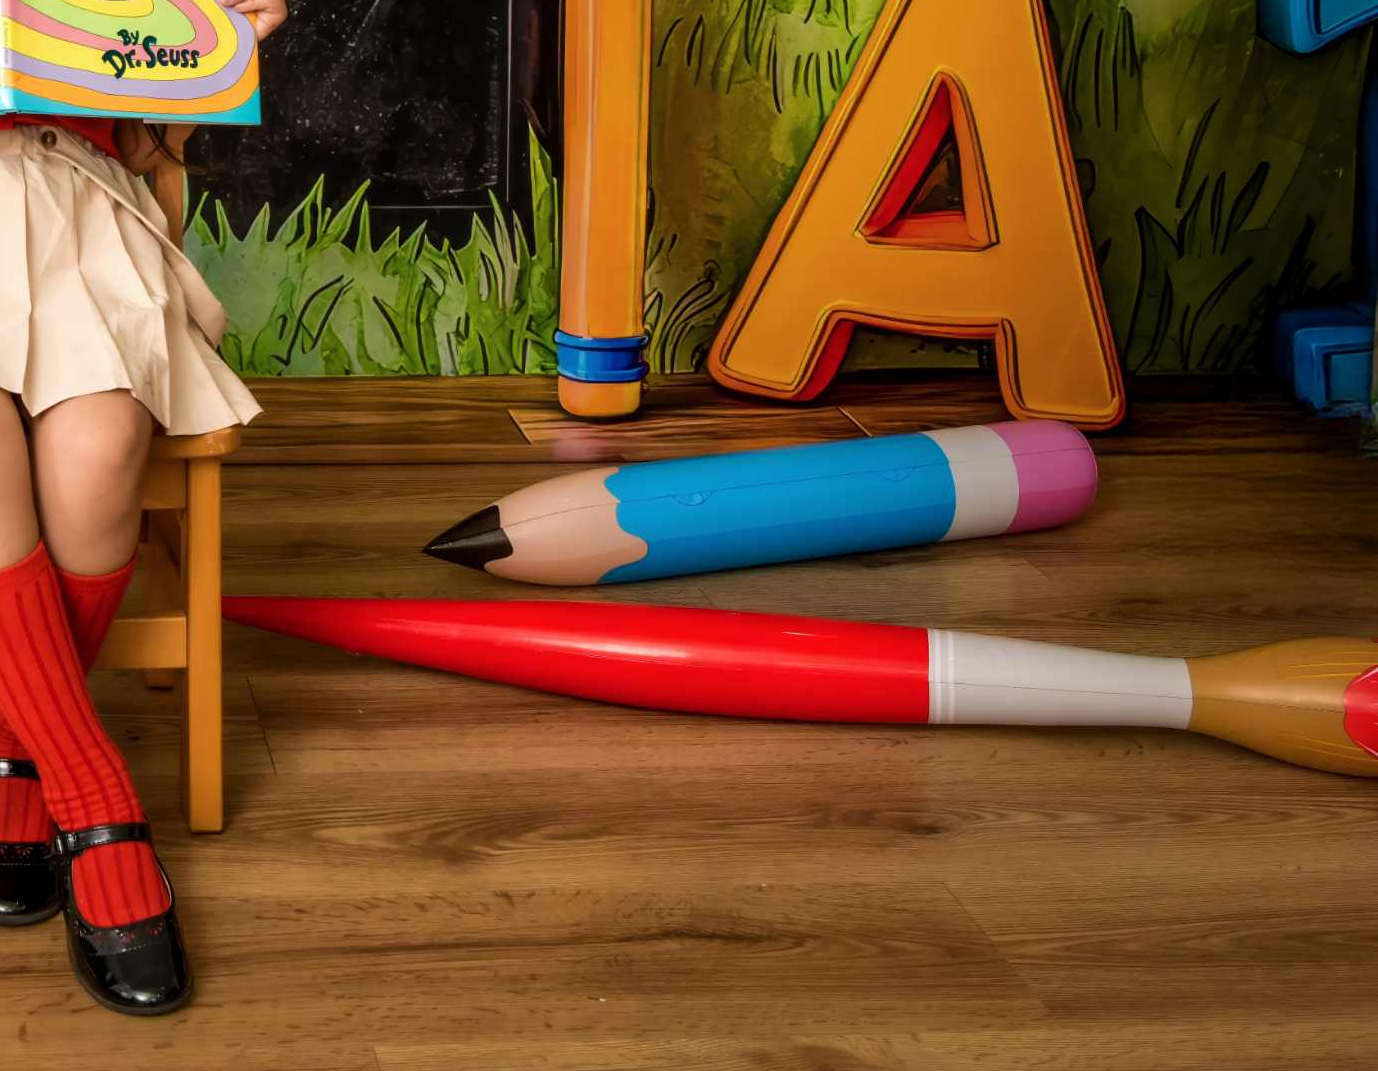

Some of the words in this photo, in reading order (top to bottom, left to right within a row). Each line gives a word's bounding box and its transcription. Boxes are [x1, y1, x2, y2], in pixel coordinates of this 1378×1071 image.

[117, 29, 139, 46] By
[102, 50, 142, 79] Dr.
[142, 35, 200, 68] Seuss
